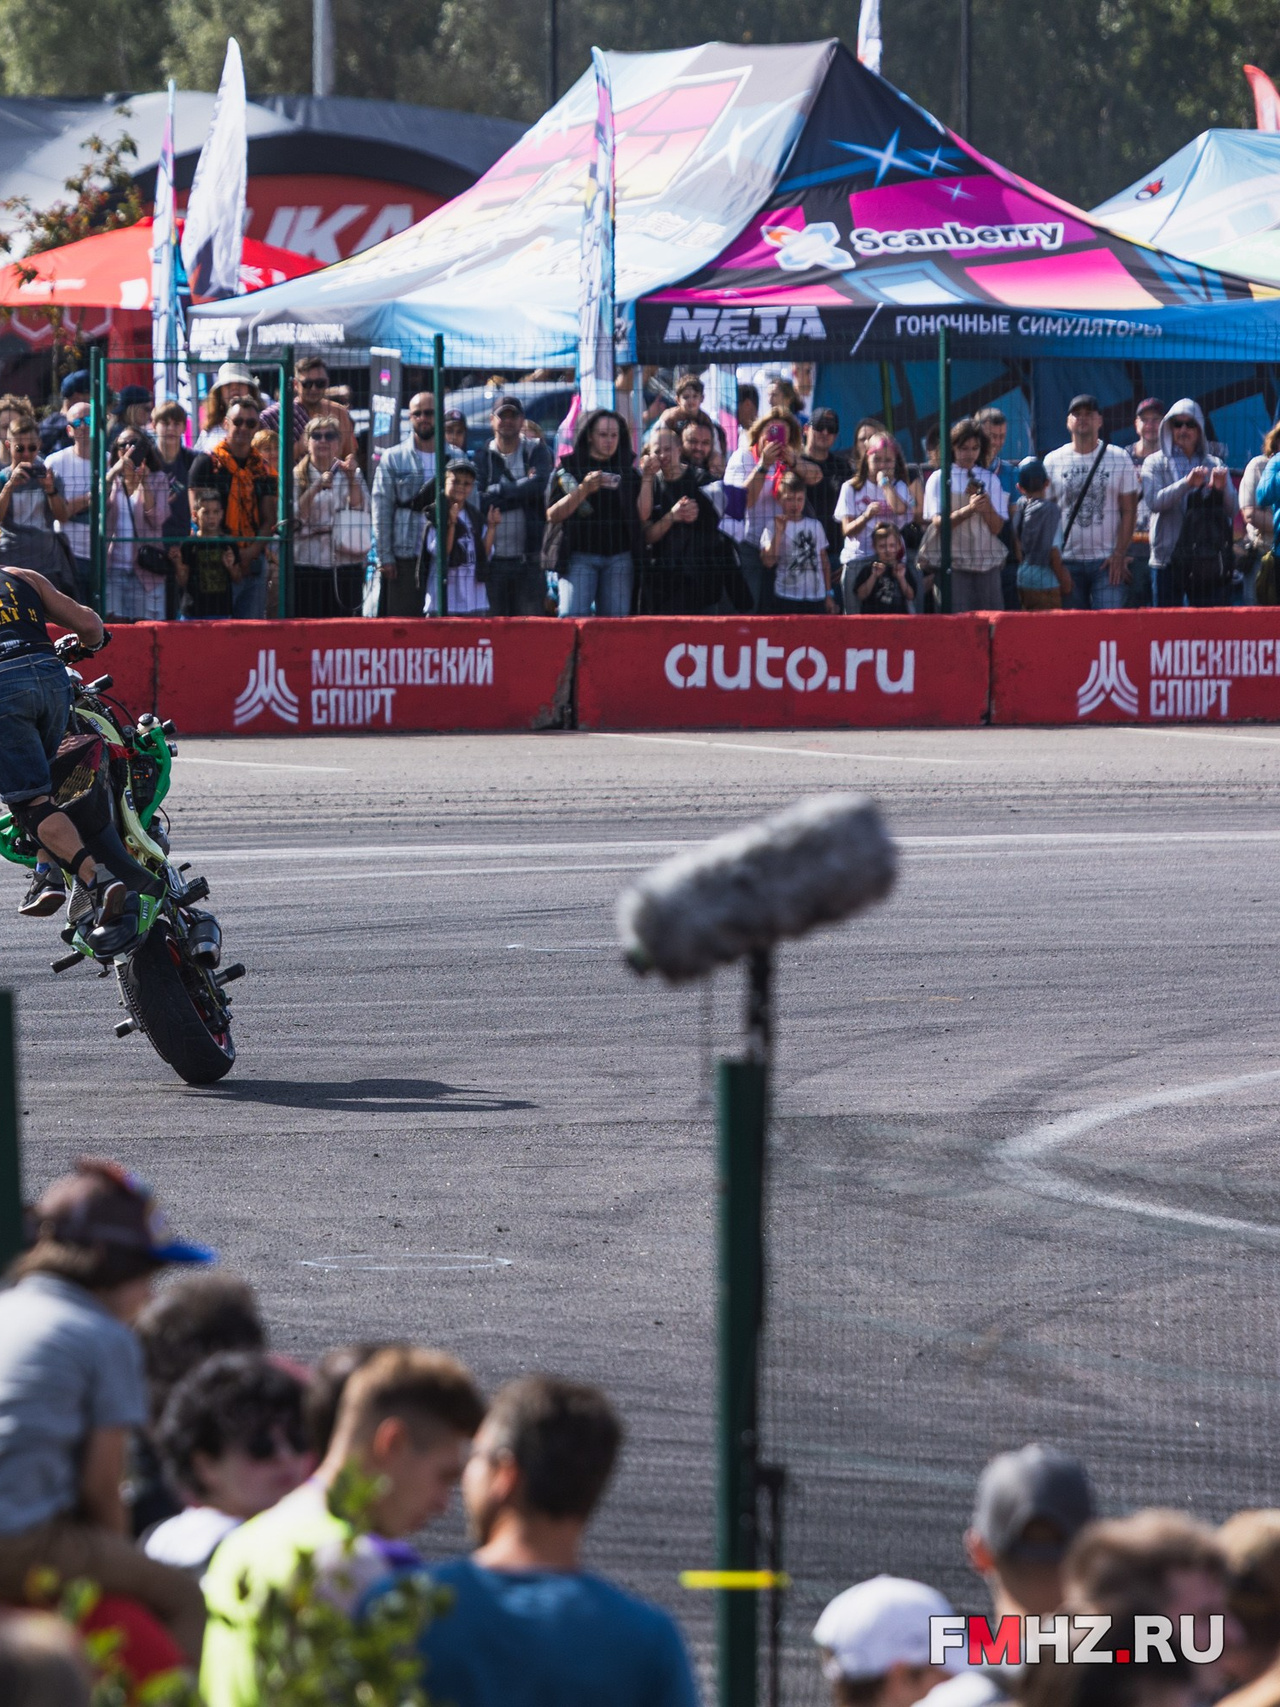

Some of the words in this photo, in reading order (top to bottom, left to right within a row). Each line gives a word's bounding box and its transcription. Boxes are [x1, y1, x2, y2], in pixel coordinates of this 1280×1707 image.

[850, 222, 1063, 255] Scanberry
[663, 306, 826, 343] META
[699, 332, 792, 353] RACING
[895, 314, 1011, 336] ГОНОЧНЫЕ
[1017, 315, 1163, 338] СИМУЛЯТОРЫ
[311, 638, 493, 686] МОСКОВСКИЙ
[664, 638, 915, 693] auto.ru
[311, 687, 396, 726] СПОРТ
[1150, 679, 1231, 717] СПОРТ
